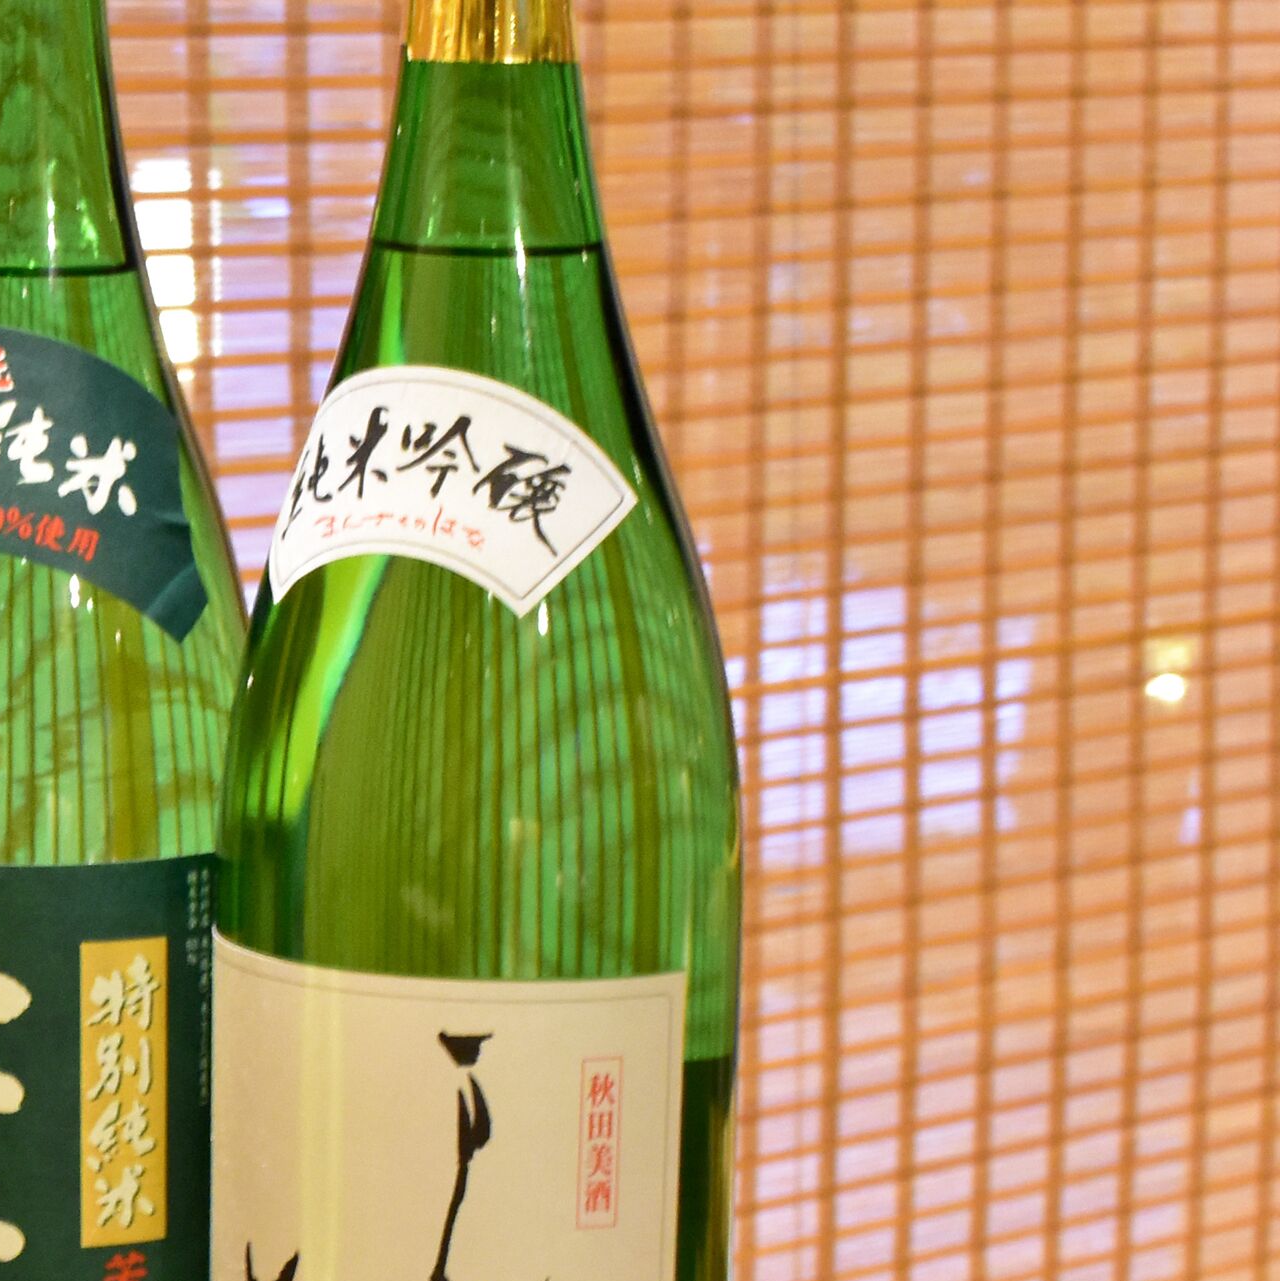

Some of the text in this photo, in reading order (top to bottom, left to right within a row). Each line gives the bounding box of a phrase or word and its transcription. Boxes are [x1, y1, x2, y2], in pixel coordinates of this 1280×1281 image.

[87, 952, 161, 1229] 特別純米
[585, 1071, 616, 1214] 秋田美酒
